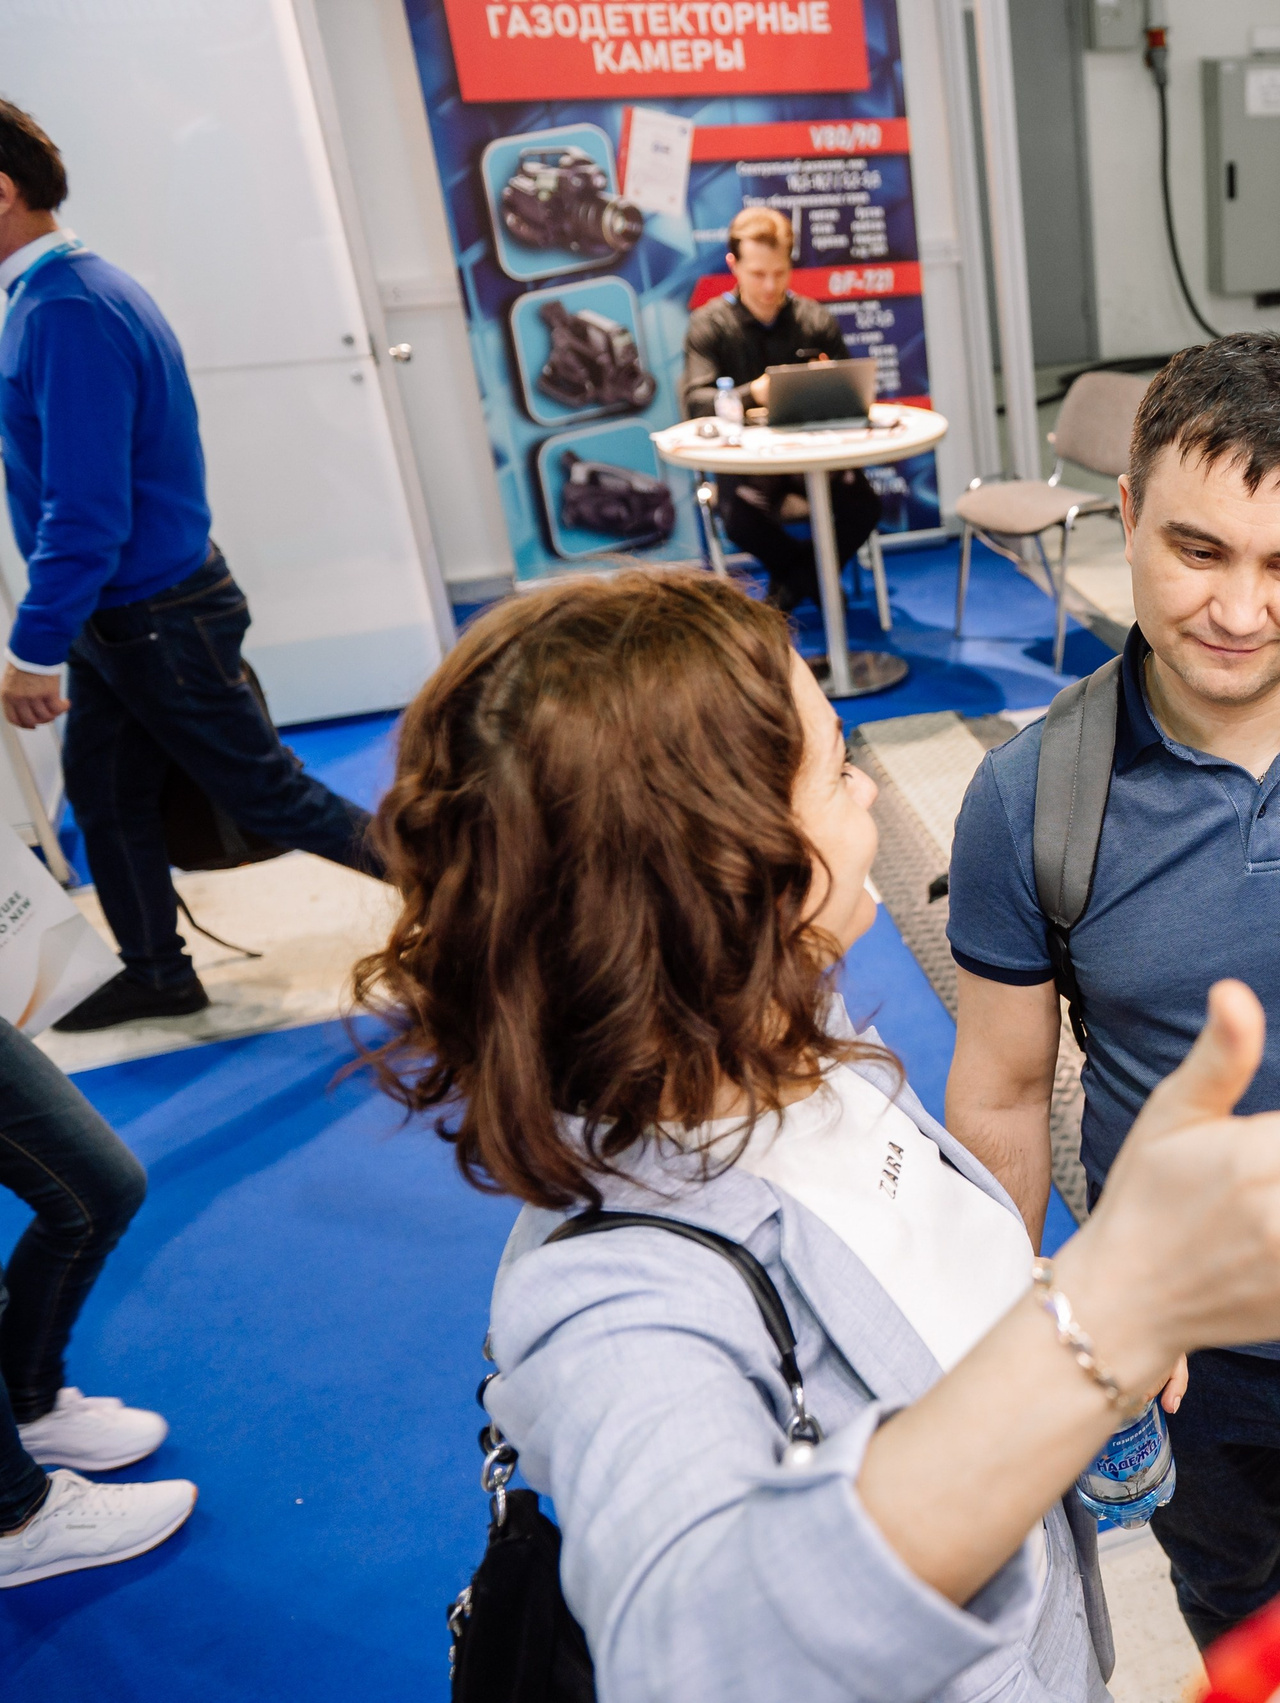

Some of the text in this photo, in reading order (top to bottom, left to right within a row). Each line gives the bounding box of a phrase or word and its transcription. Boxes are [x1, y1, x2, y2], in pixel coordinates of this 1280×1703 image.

[485, 1, 832, 42] ГАЗОДЕТЕКТОРНЫЕ
[591, 38, 746, 74] КАМЕРЫ
[879, 1141, 904, 1199] ZARA
